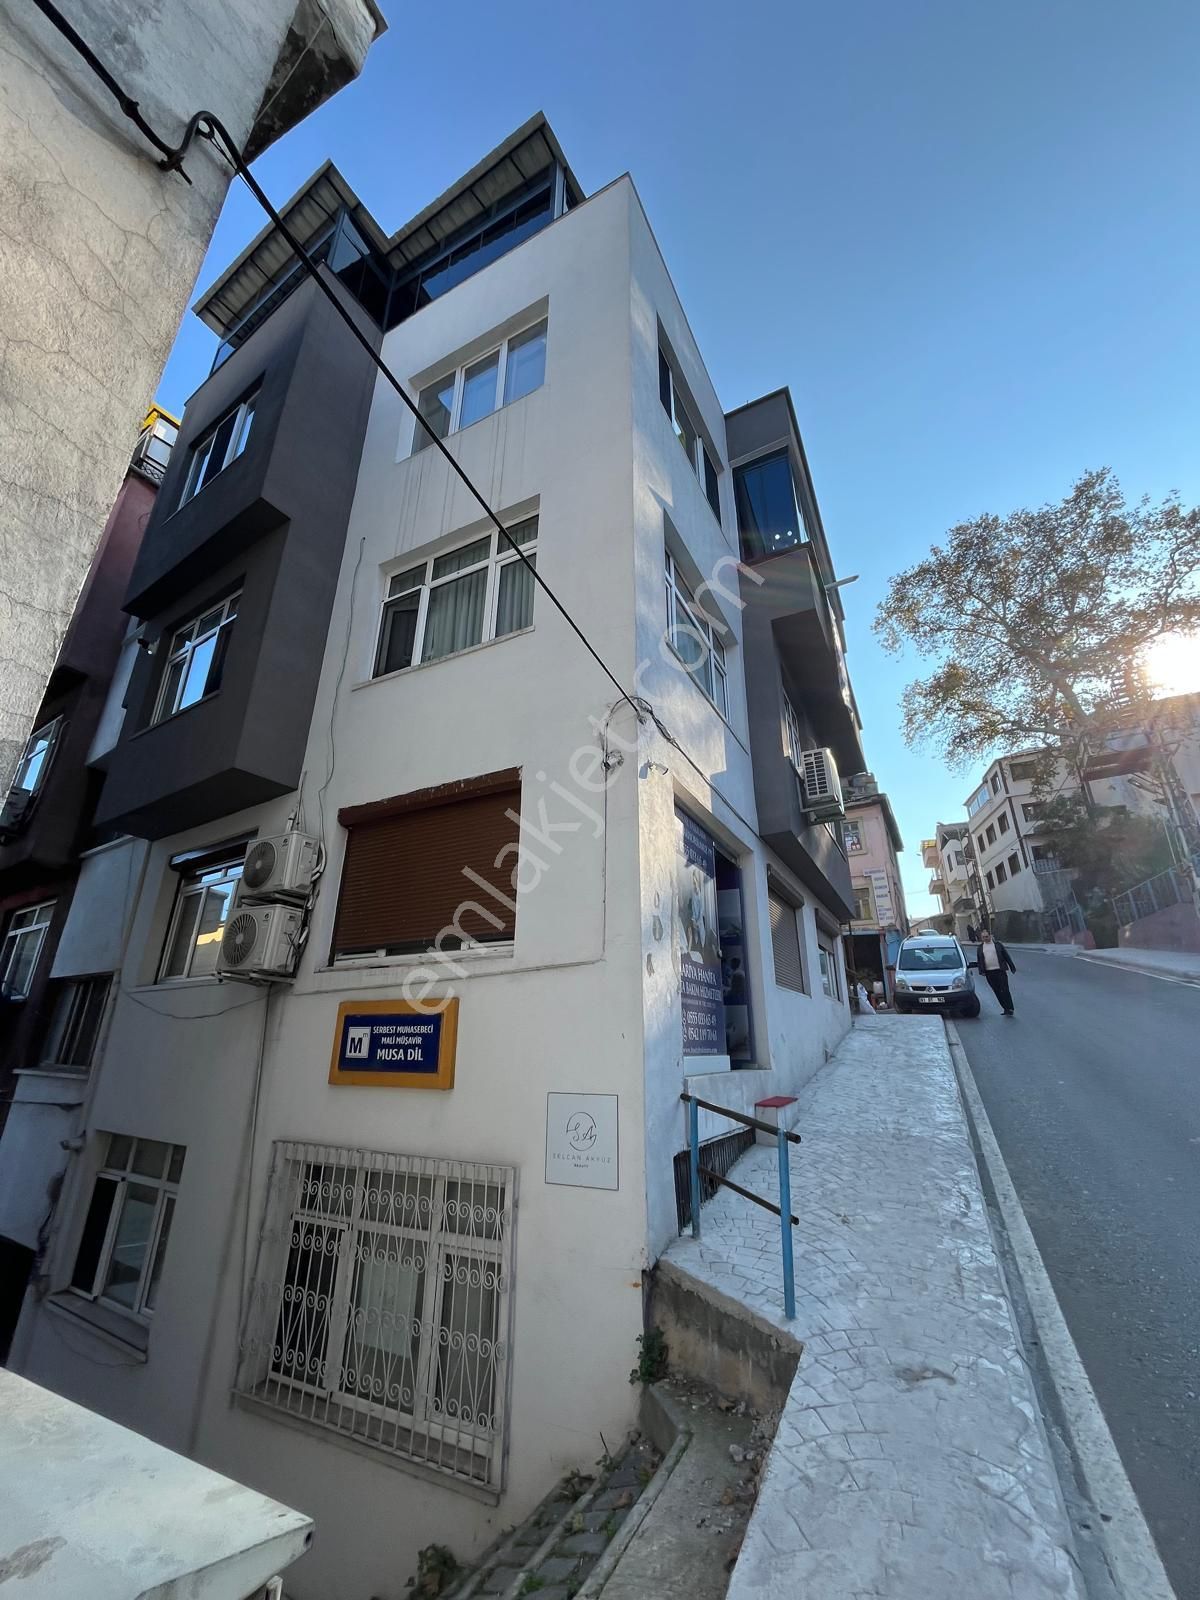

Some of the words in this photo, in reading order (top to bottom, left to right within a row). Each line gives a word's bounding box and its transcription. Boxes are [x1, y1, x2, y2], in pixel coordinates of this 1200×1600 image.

[373, 1025, 396, 1034] SERBEST
[397, 1024, 433, 1034] MUHASEBECİ
[381, 1036, 395, 1045] MALİ
[395, 1035, 423, 1046] MÜŞAVİR
[377, 1048, 404, 1060] MUSA
[407, 1046, 424, 1061] DİL
